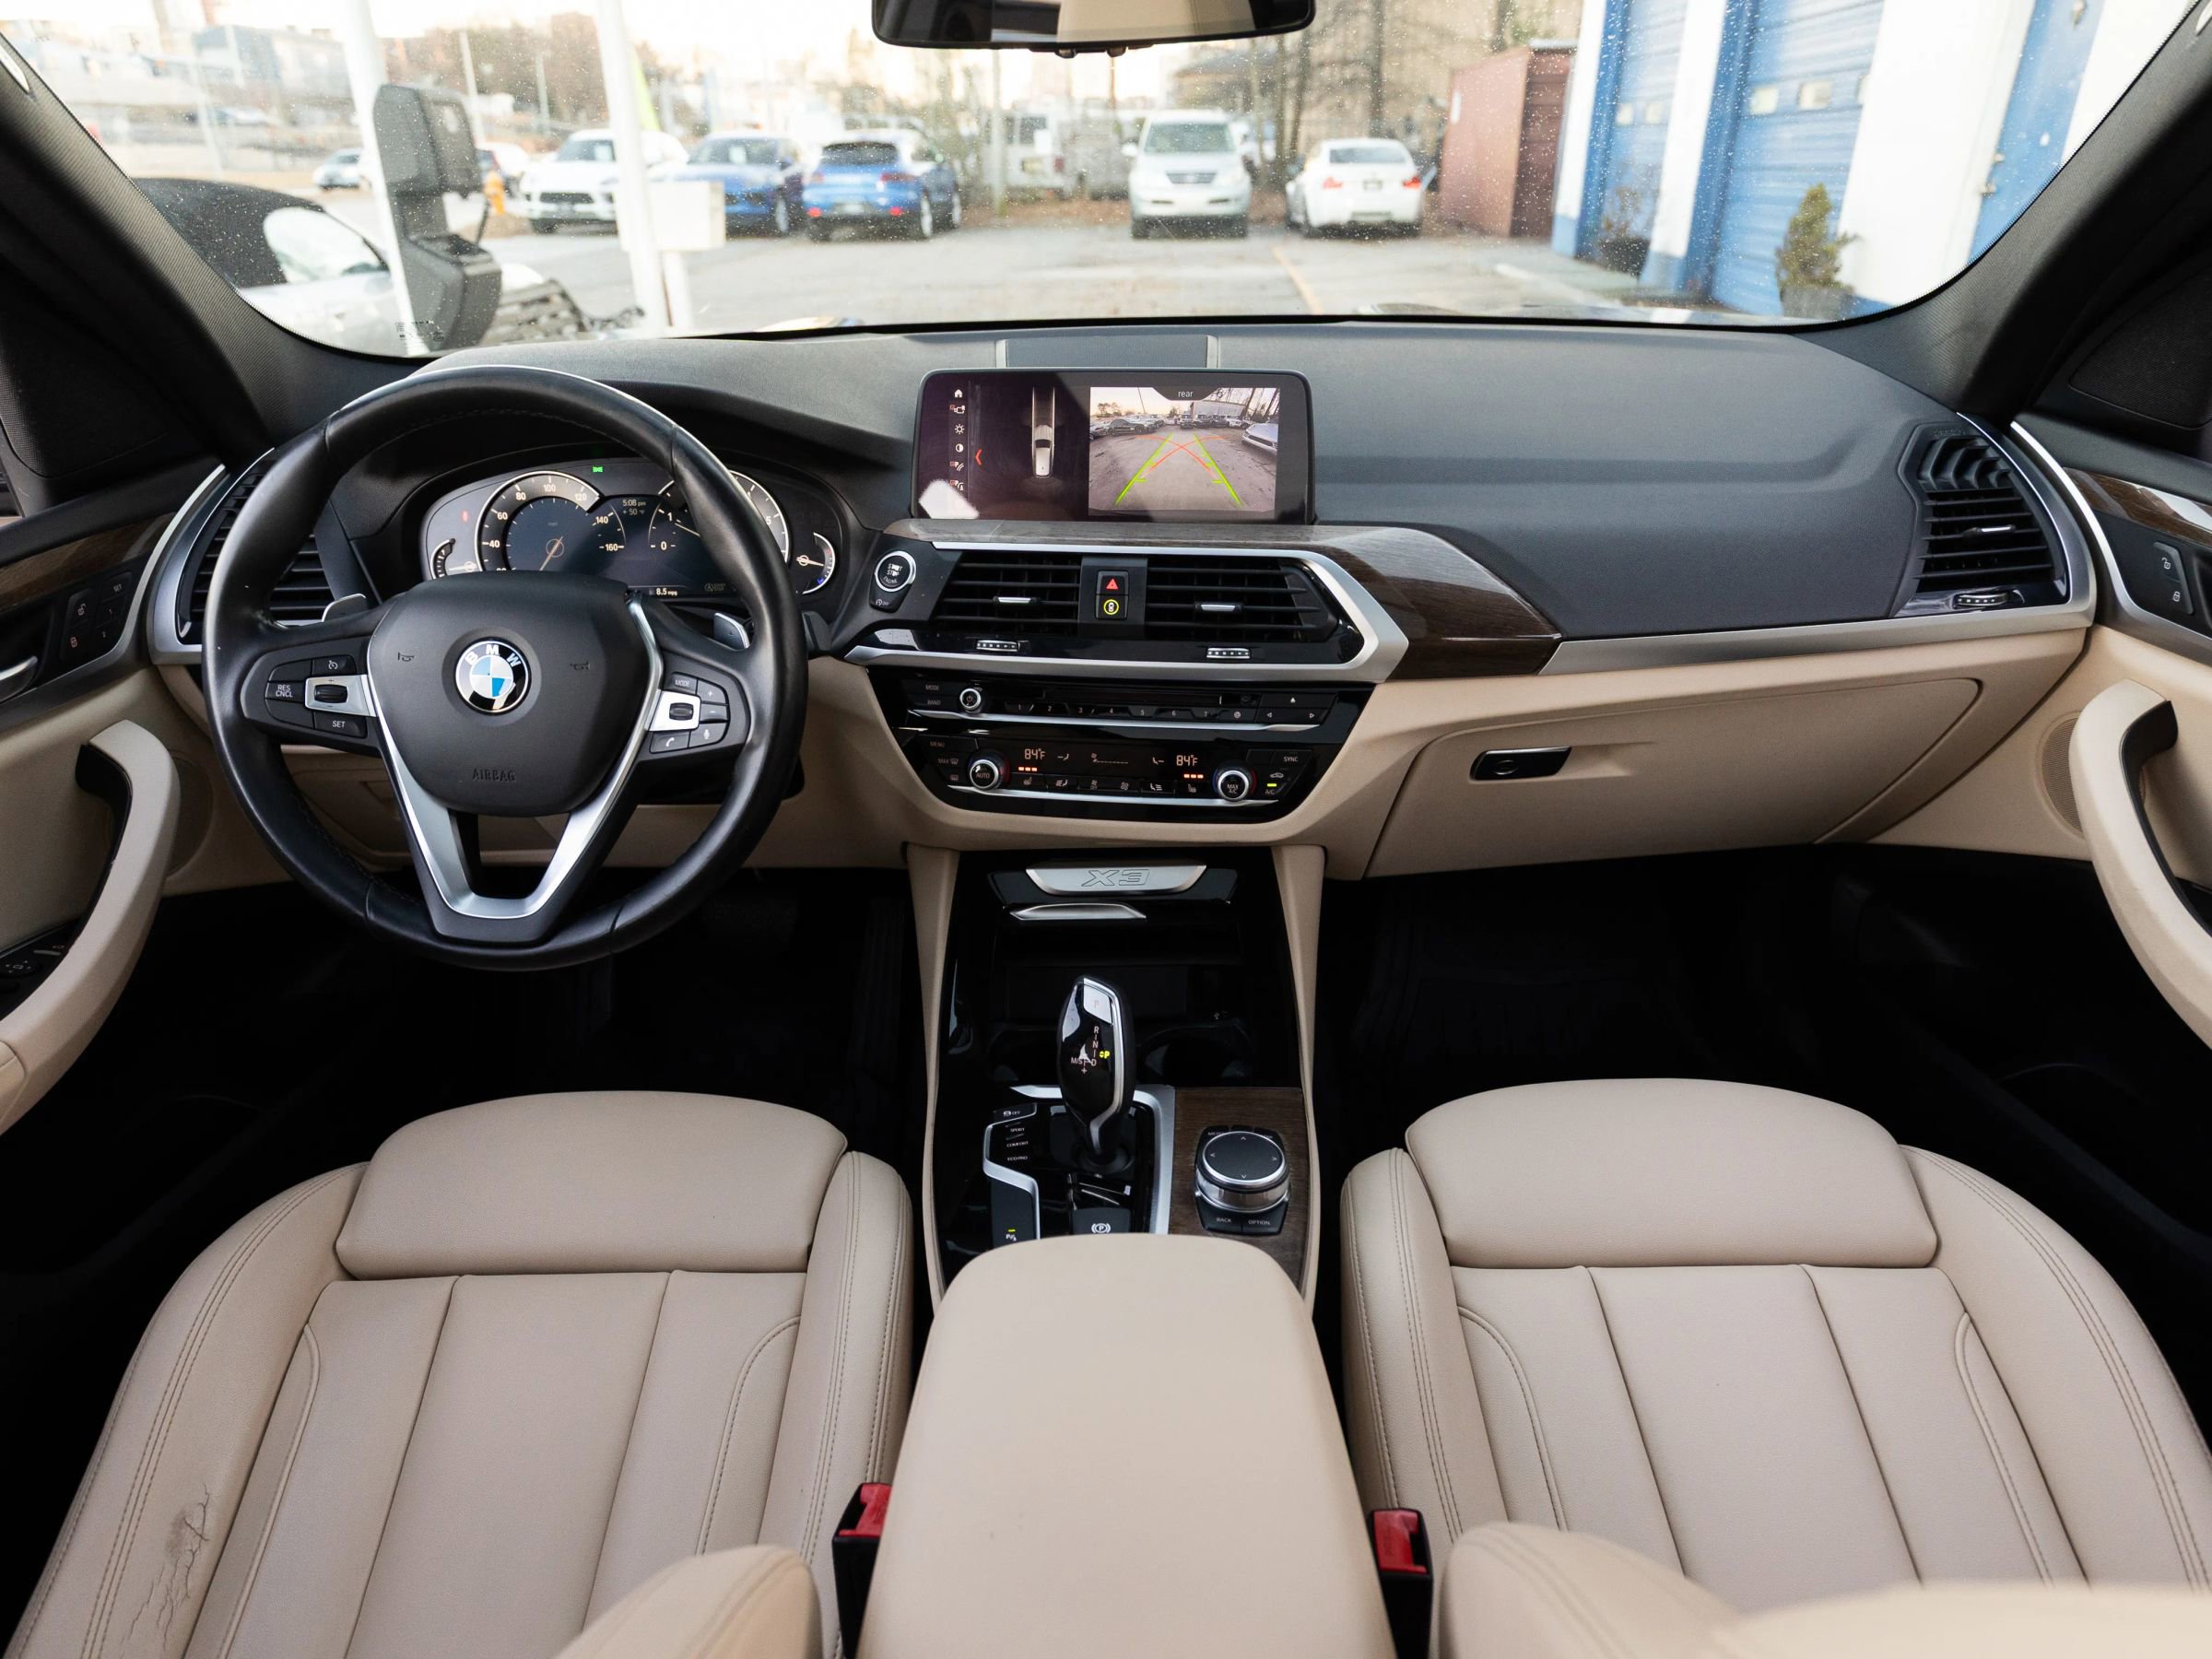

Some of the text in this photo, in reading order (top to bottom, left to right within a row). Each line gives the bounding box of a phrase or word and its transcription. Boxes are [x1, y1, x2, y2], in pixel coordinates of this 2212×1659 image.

[543, 484, 557, 492] 100
[515, 491, 526, 500] 80
[574, 493, 587, 501] 120
[497, 512, 508, 520] 60
[595, 515, 608, 524] 140
[667, 512, 672, 522] 1
[765, 516, 771, 525] 5
[488, 540, 500, 548] 40
[605, 543, 618, 551] 160
[660, 541, 667, 550] 0
[465, 643, 522, 667] BMW
[332, 720, 346, 728] SET
[472, 768, 516, 782] AIRBAG
[1081, 868, 1150, 888] X3
[1093, 1026, 1100, 1034] R
[1092, 1041, 1099, 1049] N
[1090, 1058, 1097, 1066] D
